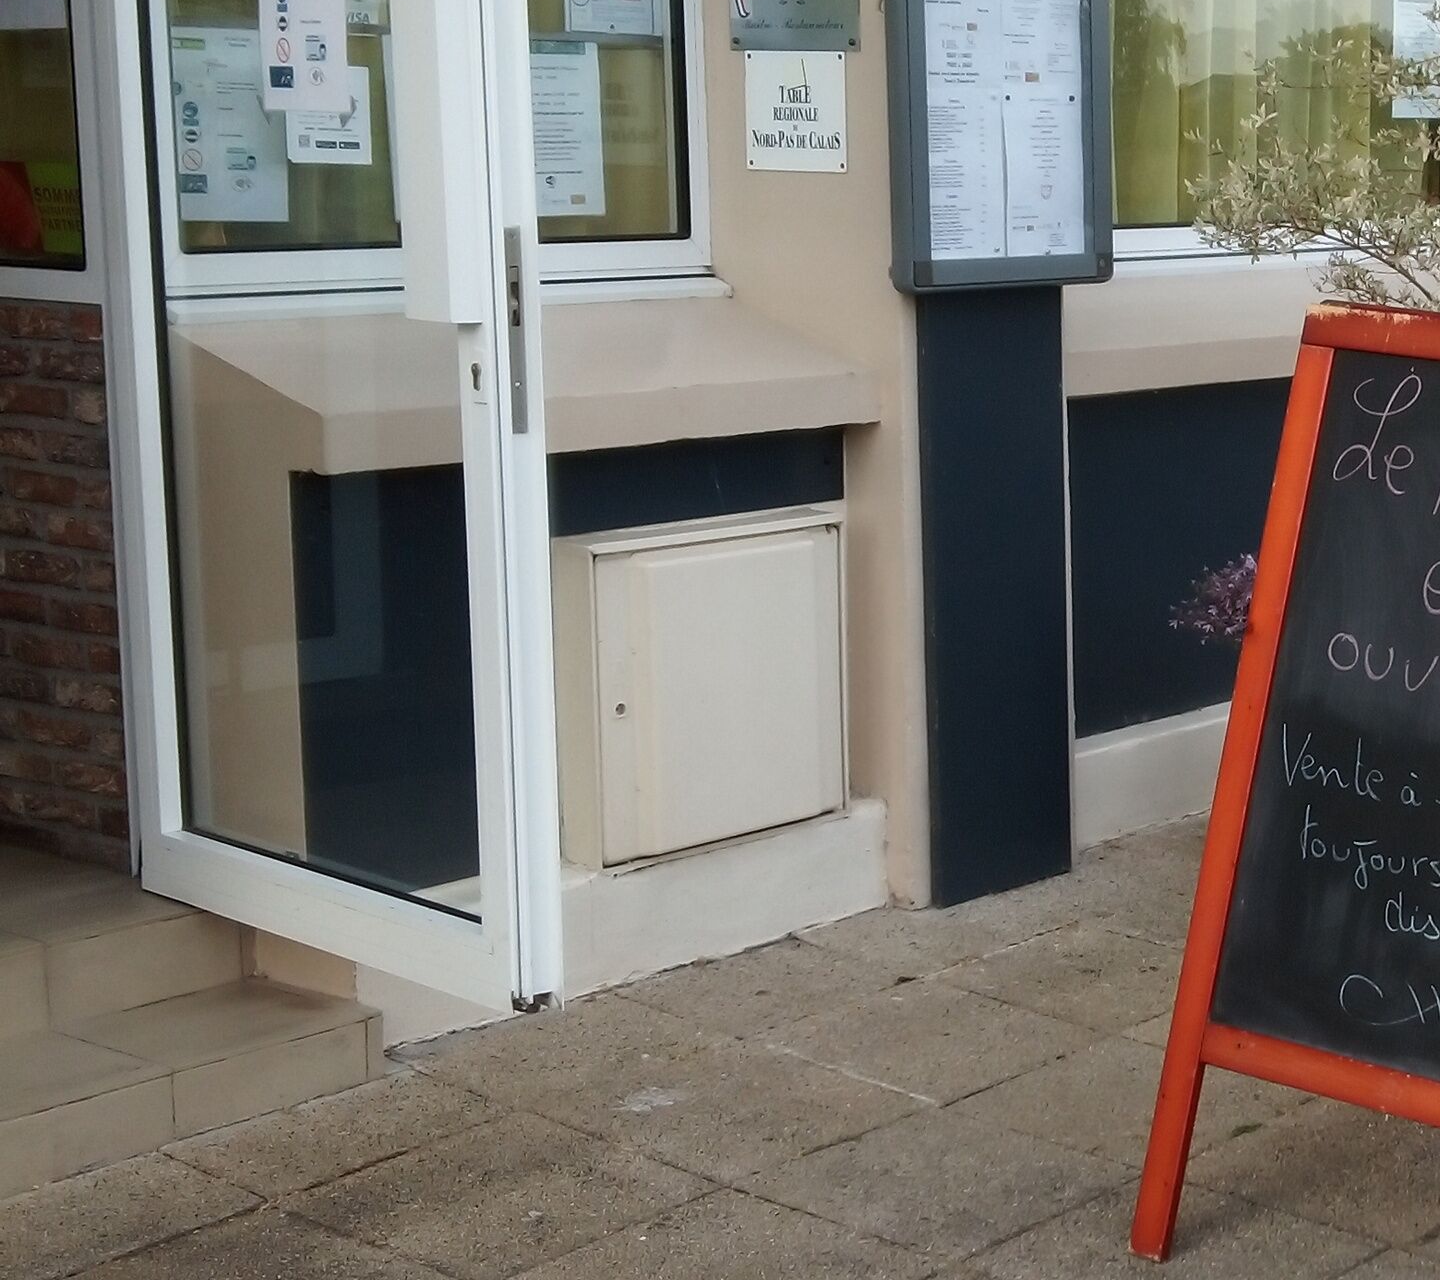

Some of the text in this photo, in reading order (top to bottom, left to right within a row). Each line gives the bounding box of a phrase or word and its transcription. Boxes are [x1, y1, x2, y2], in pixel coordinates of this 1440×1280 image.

[778, 85, 812, 104] TABLE
[1332, 372, 1423, 496] Le
[1281, 722, 1385, 802] Vente
[1400, 772, 1423, 808] à
